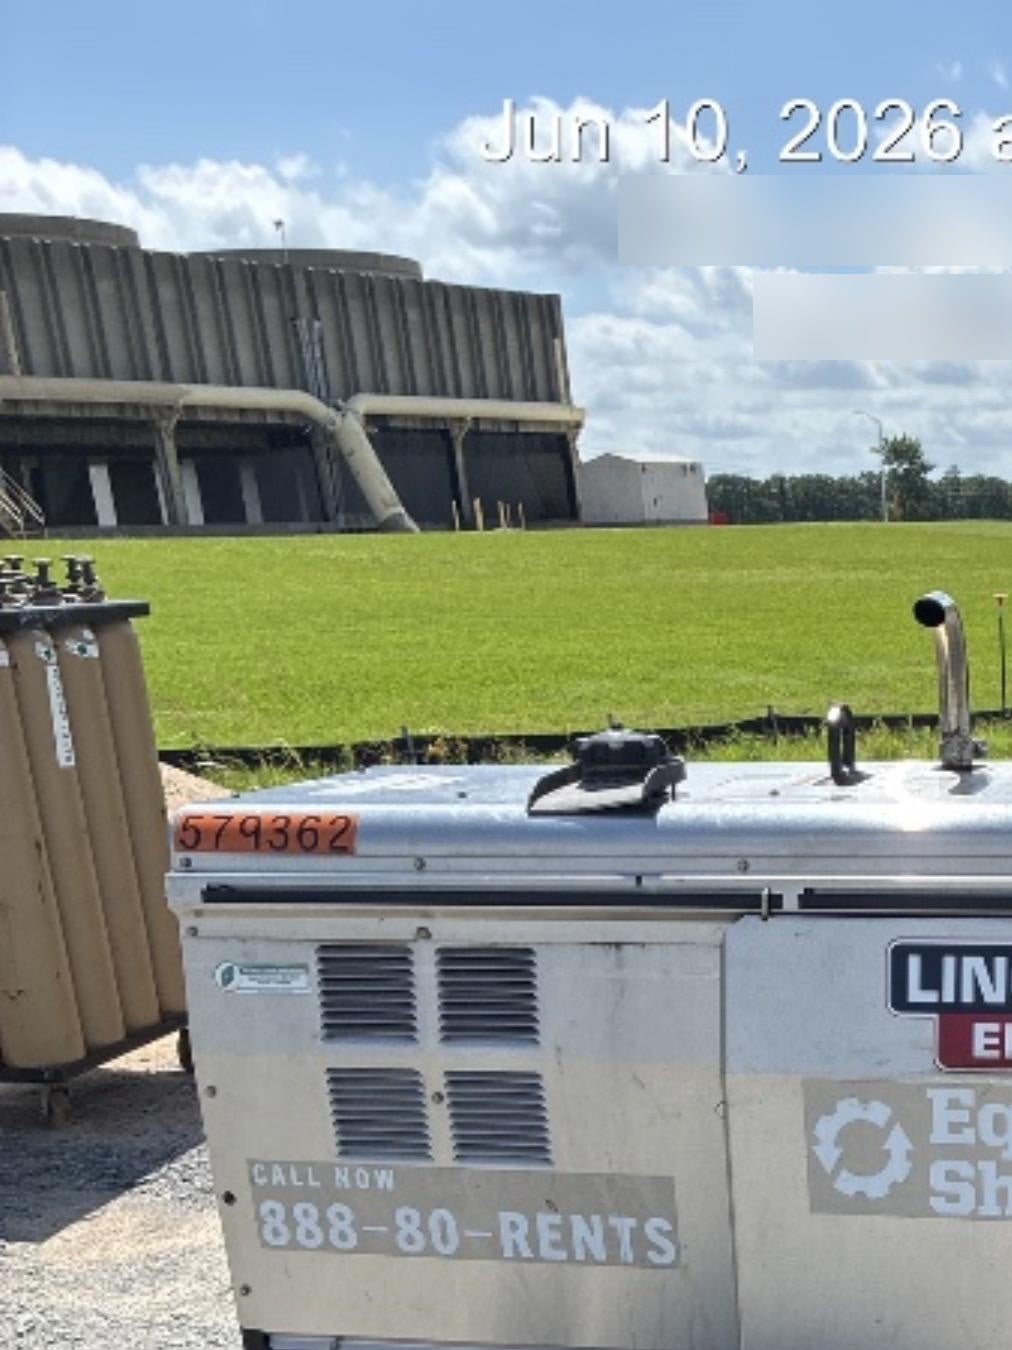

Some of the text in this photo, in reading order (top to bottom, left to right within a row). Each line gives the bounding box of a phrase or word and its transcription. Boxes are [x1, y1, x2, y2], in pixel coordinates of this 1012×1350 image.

[177, 813, 352, 852] 579362
[252, 1162, 396, 1192] CALL NOW
[258, 1199, 677, 1266] 888-80-RENTS
